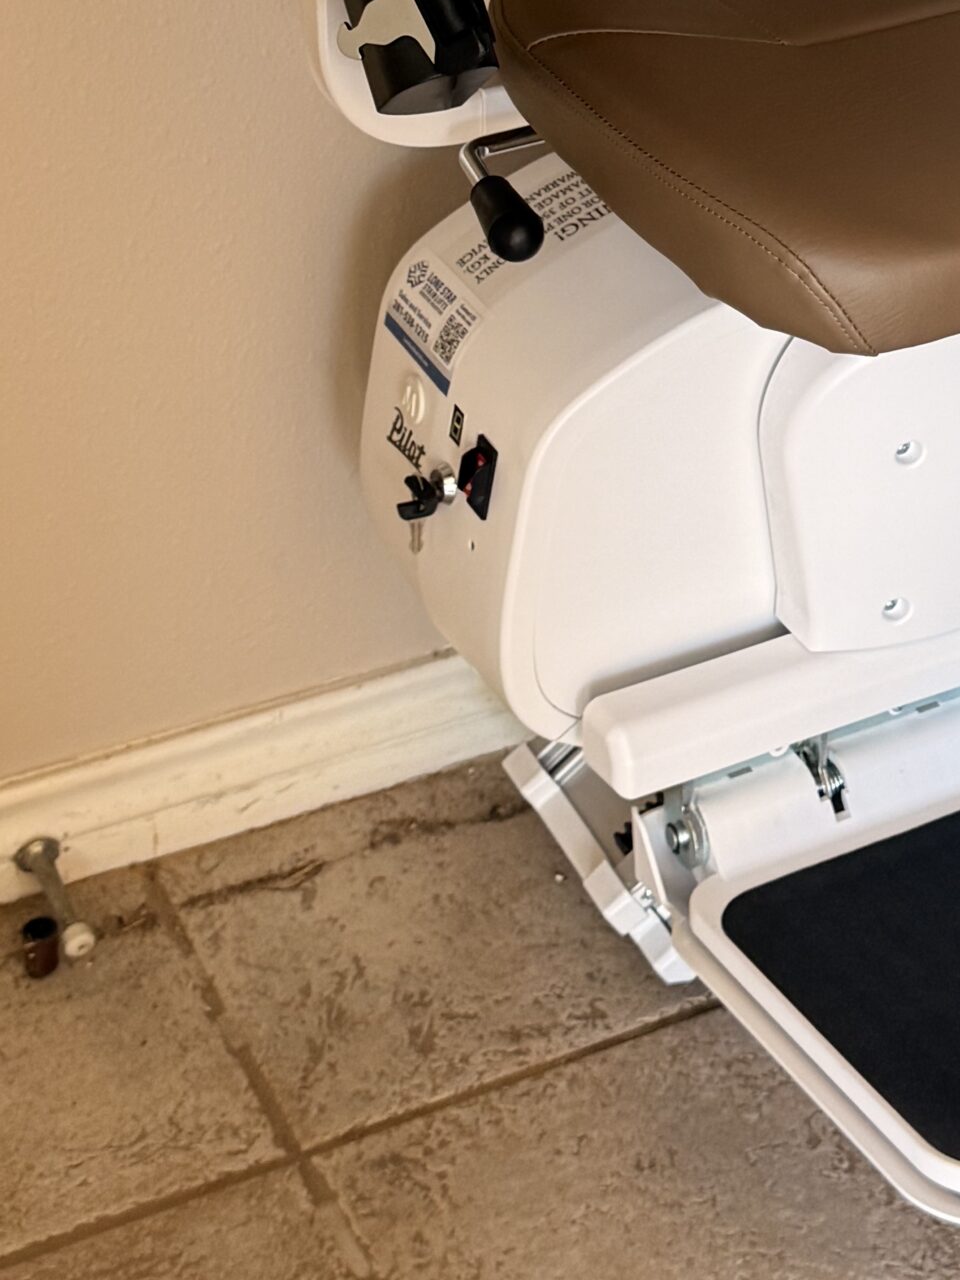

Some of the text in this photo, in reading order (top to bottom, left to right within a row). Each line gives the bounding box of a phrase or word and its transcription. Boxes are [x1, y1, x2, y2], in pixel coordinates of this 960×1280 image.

[525, 171, 577, 203] WARRAN
[559, 197, 576, 210] OF
[581, 196, 600, 208] OR
[553, 206, 582, 225] ONE
[554, 204, 612, 241] ING!
[456, 240, 488, 269] VICE
[440, 286, 457, 305] STAR
[386, 406, 426, 473] Pilot
